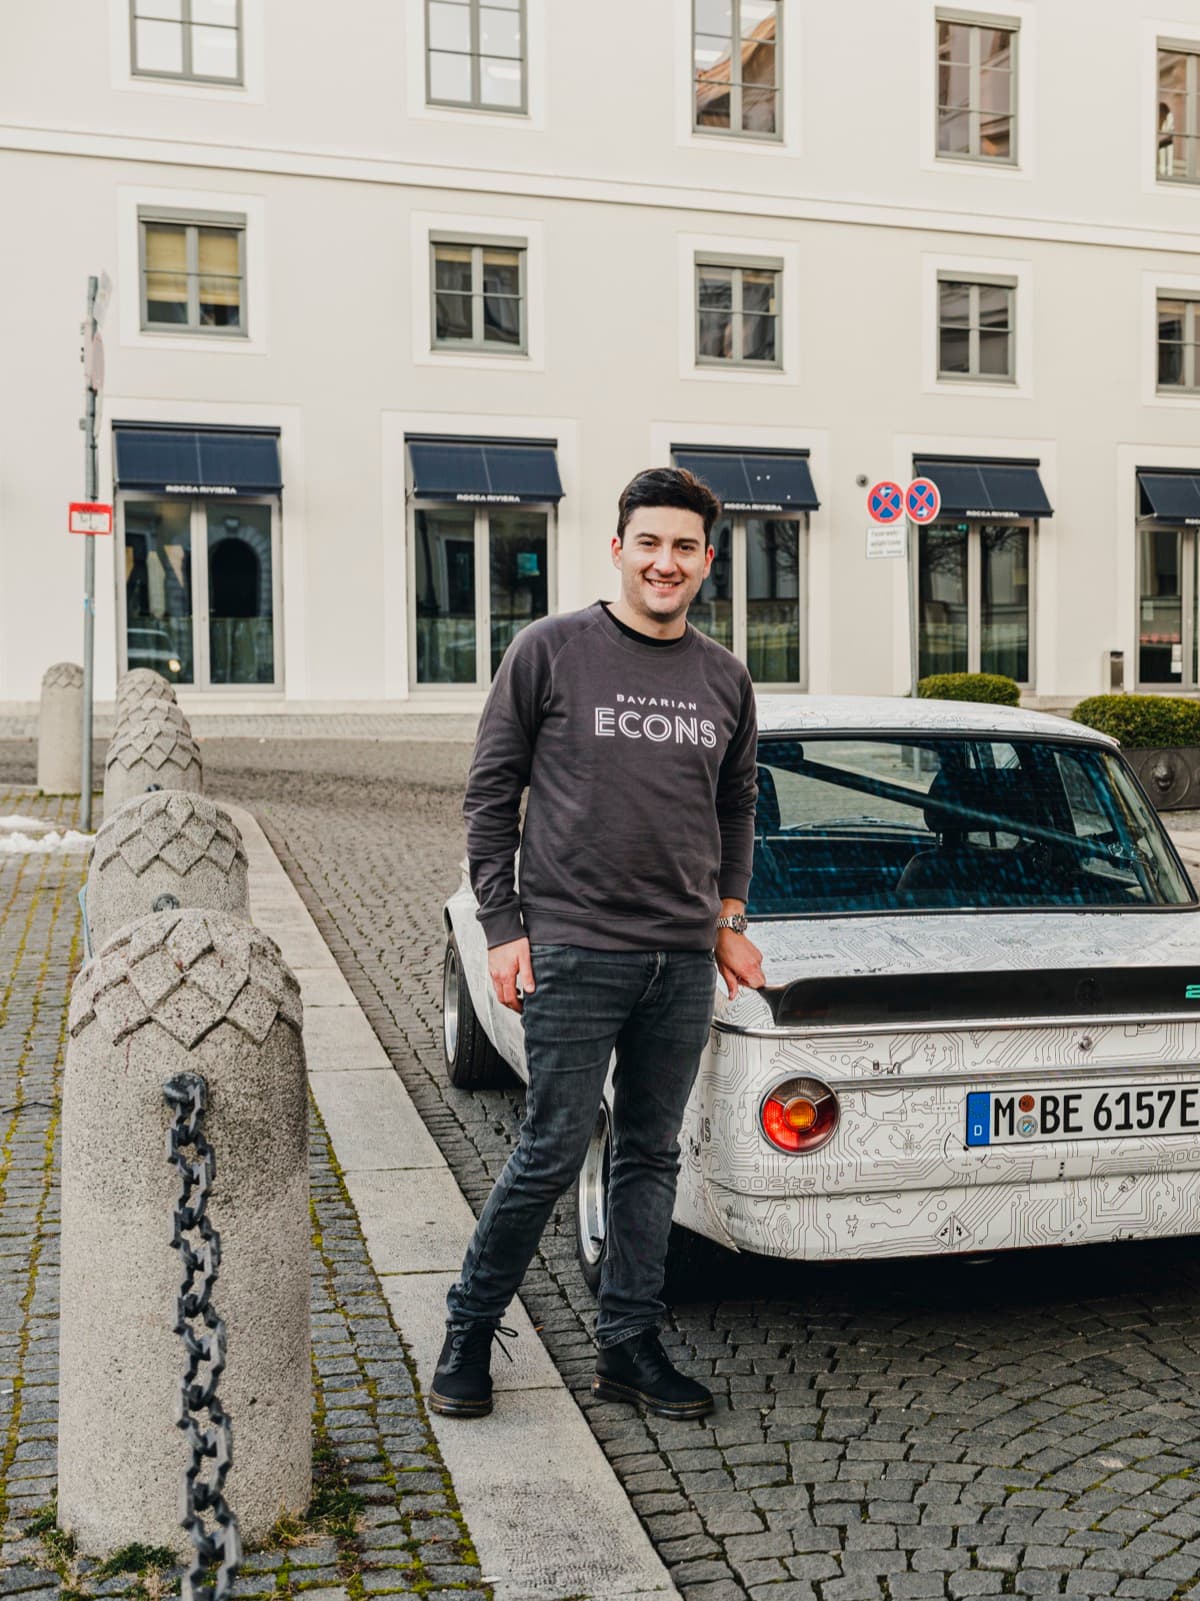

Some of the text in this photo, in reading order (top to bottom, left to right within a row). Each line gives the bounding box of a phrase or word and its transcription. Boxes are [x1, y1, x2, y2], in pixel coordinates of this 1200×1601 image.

[165, 484, 238, 495] ROCCA RIVIERA
[456, 493, 487, 502] ROCCA
[616, 693, 697, 711] BAVARIAN
[594, 707, 717, 748] ECONS
[993, 1089, 1199, 1137] M BE 6157E
[973, 1124, 983, 1137] D
